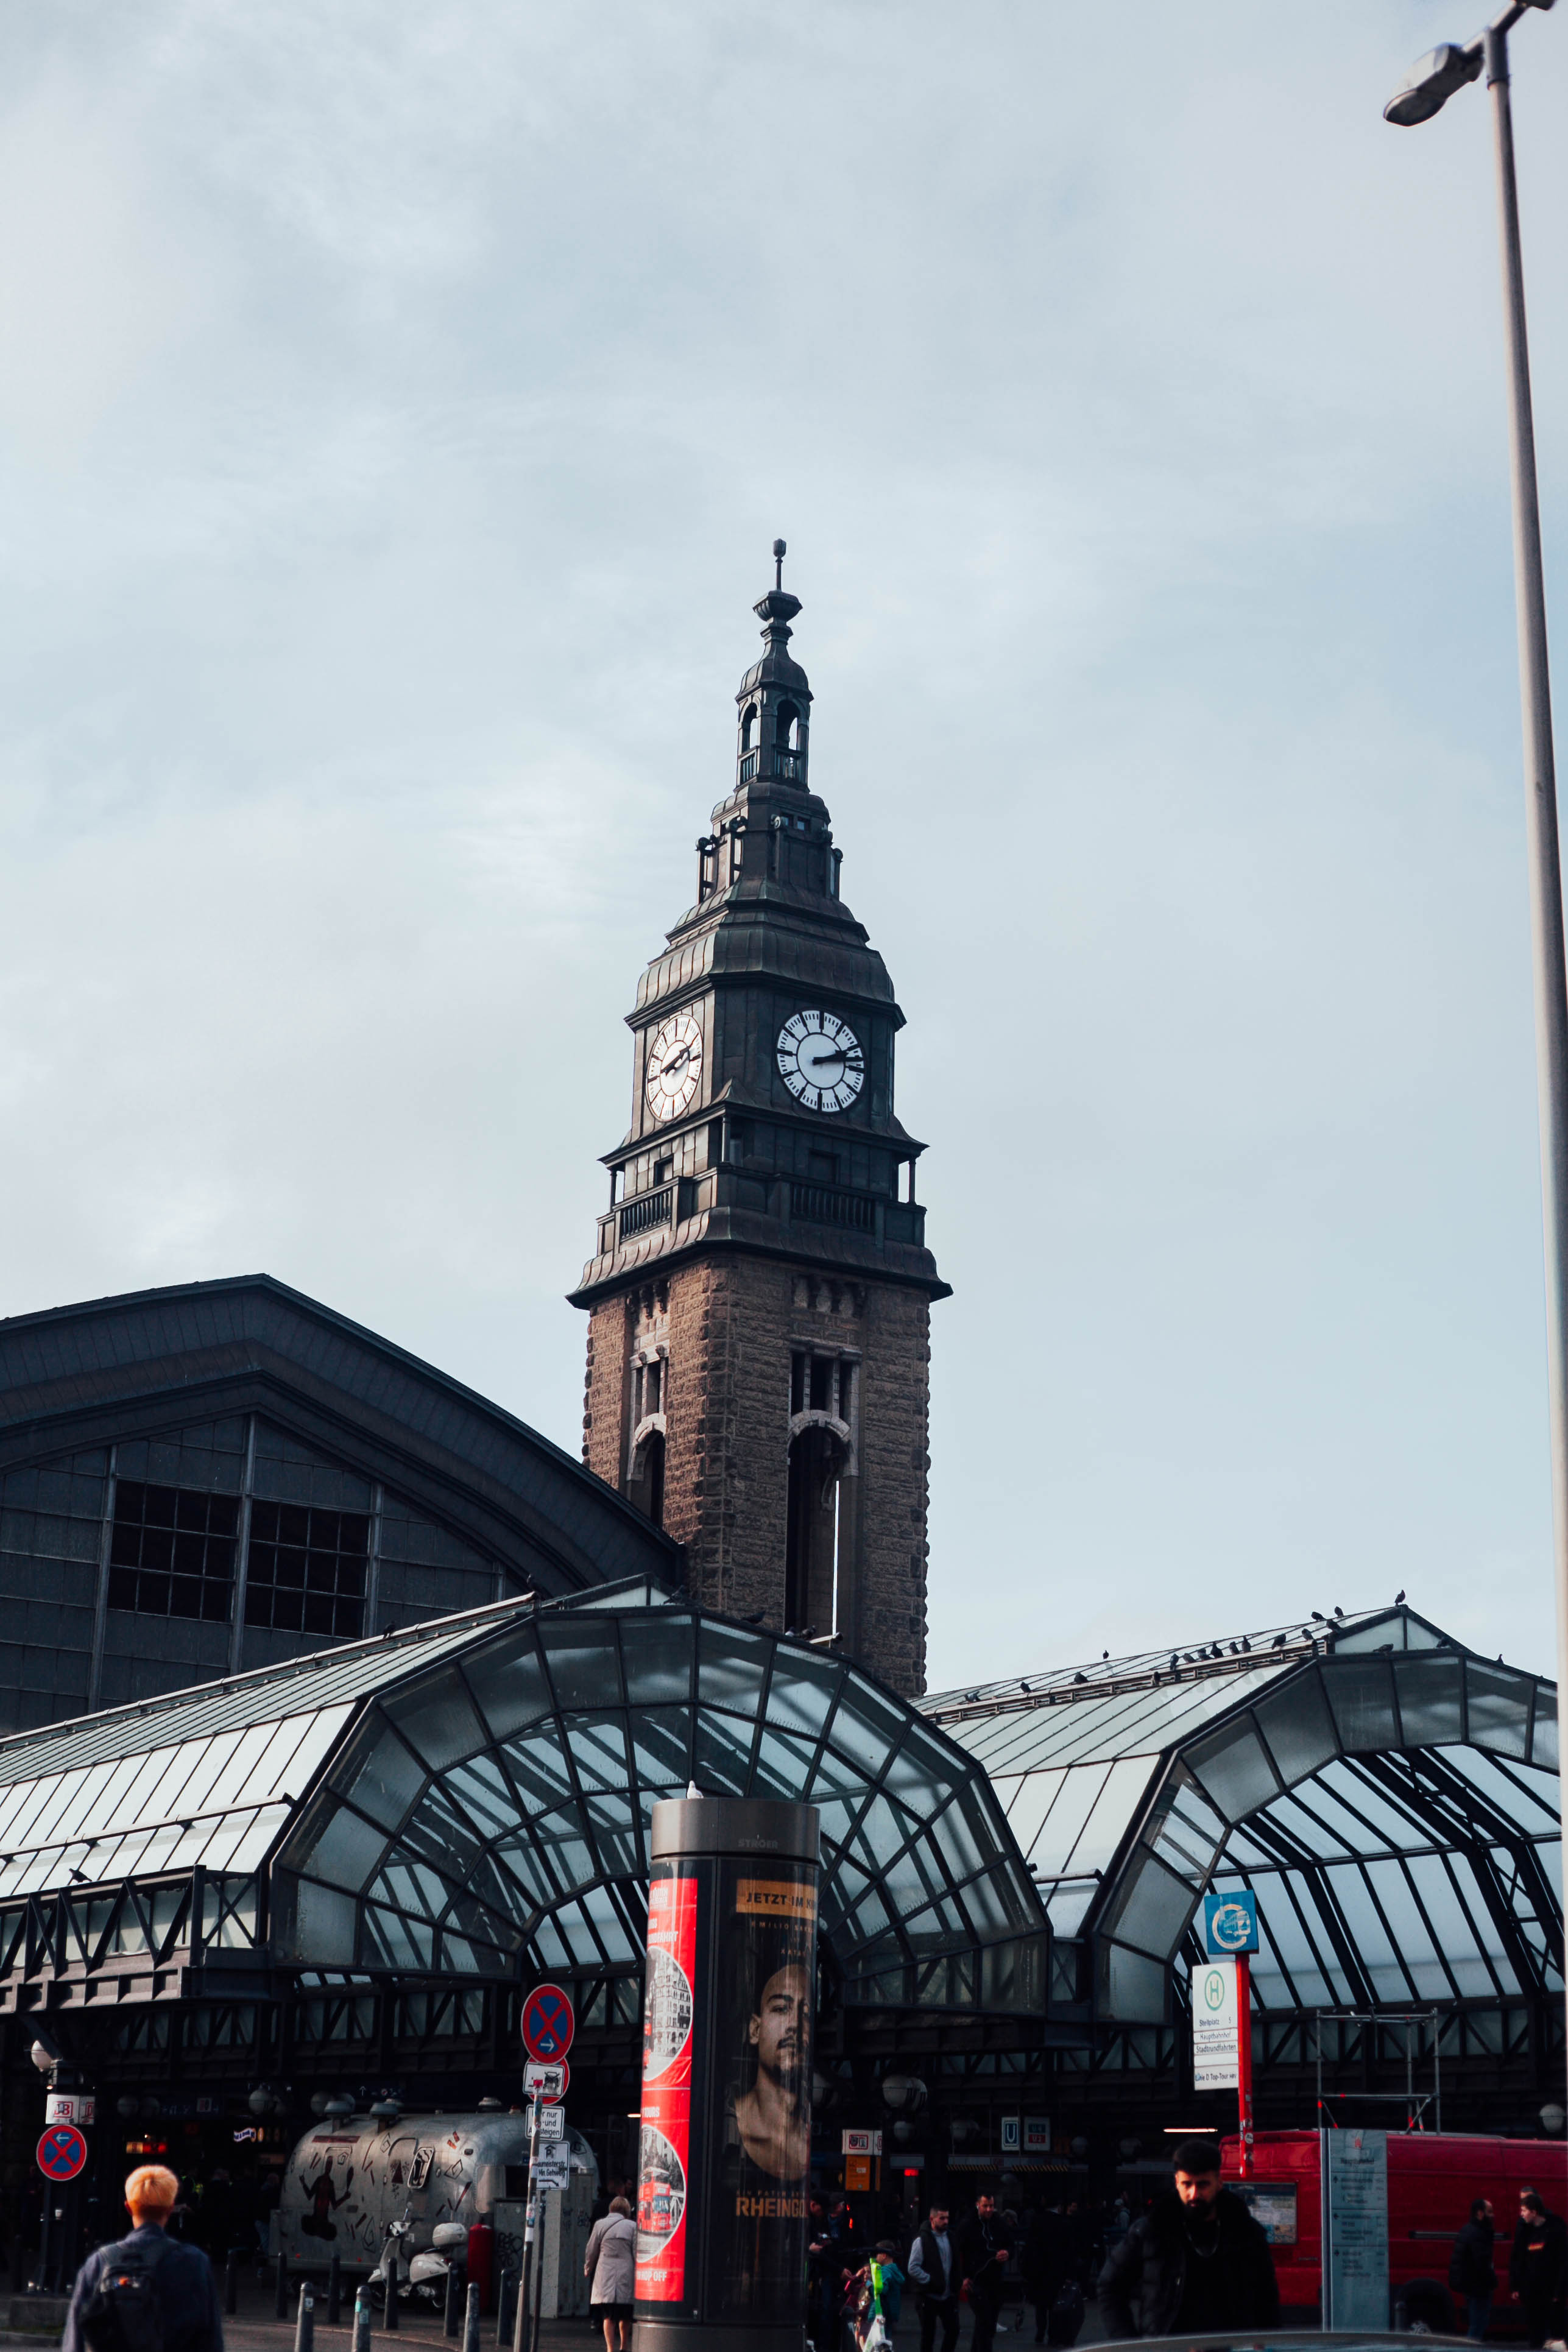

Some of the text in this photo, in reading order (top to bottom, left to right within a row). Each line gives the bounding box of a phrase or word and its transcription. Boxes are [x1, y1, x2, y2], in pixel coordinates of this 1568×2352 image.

[746, 1892, 787, 1905] JETZT
[791, 1895, 804, 1908] IM
[1199, 2019, 1220, 2027] Stellplatz
[1200, 2031, 1231, 2043] Hauptbahnhof
[1196, 2044, 1237, 2054] Stadtrundfahrten
[1210, 2072, 1229, 2082] Top-Tour
[528, 2128, 560, 2138] Asteigen
[1007, 2124, 1015, 2142] U
[546, 2167, 565, 2178] Gehweg
[652, 2270, 667, 2281] OFF
